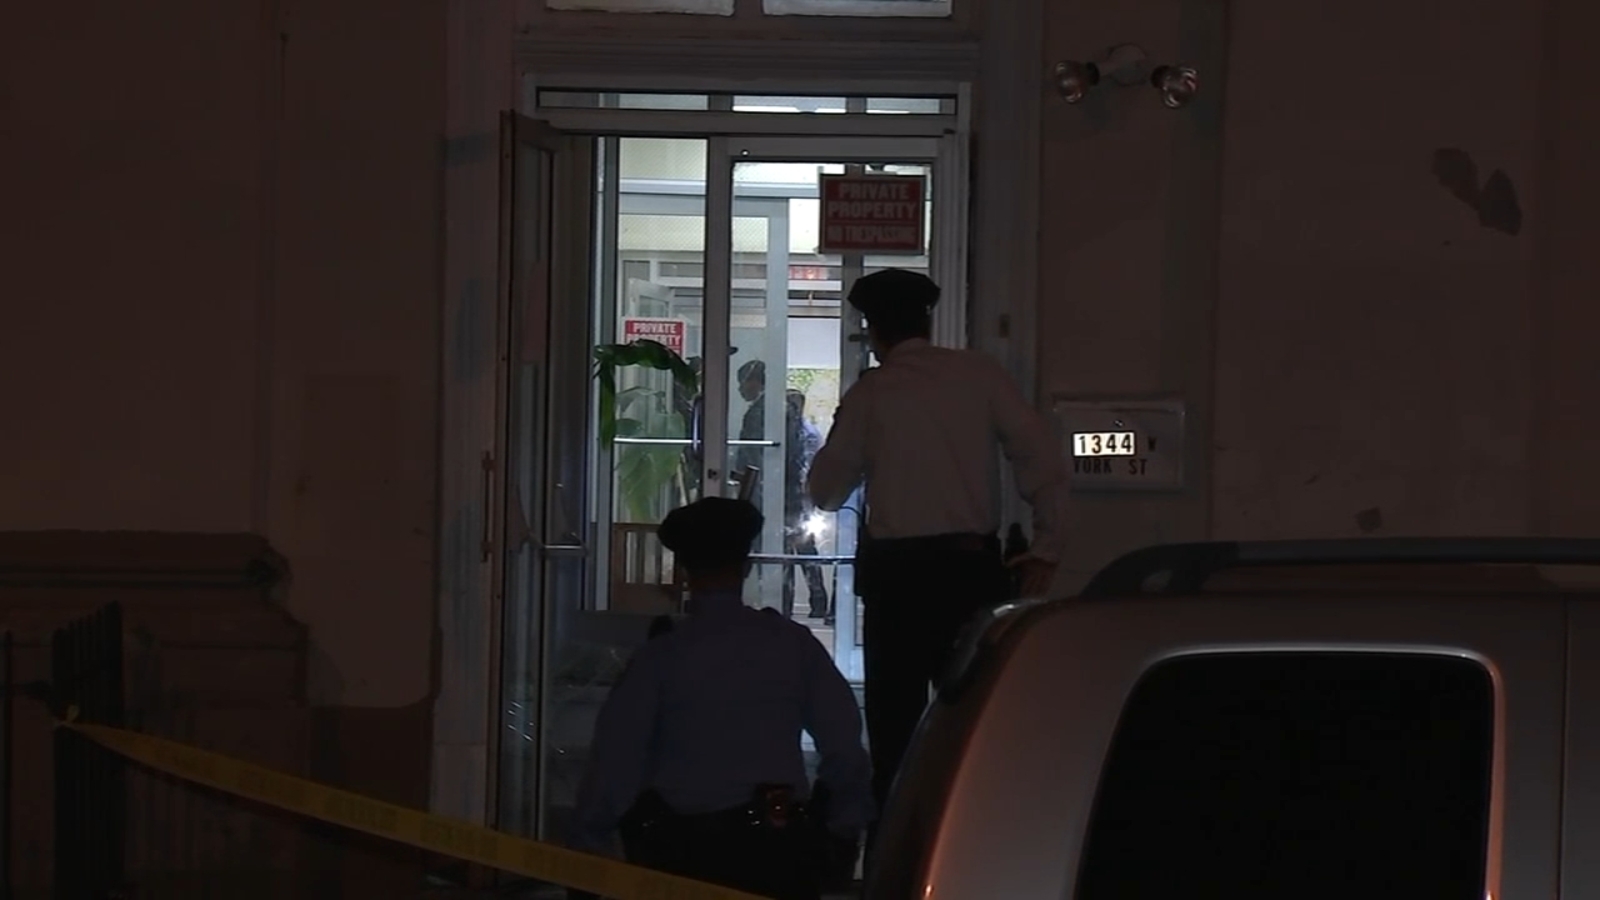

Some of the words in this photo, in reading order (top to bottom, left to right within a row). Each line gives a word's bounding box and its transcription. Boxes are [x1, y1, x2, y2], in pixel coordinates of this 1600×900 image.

[839, 182, 910, 200] PRIVATE
[828, 201, 917, 219] PROPERTY
[633, 322, 676, 334] PRIVATE
[1078, 434, 1132, 454] 1344
[1073, 459, 1112, 474] YORK
[1129, 459, 1148, 475] ST
